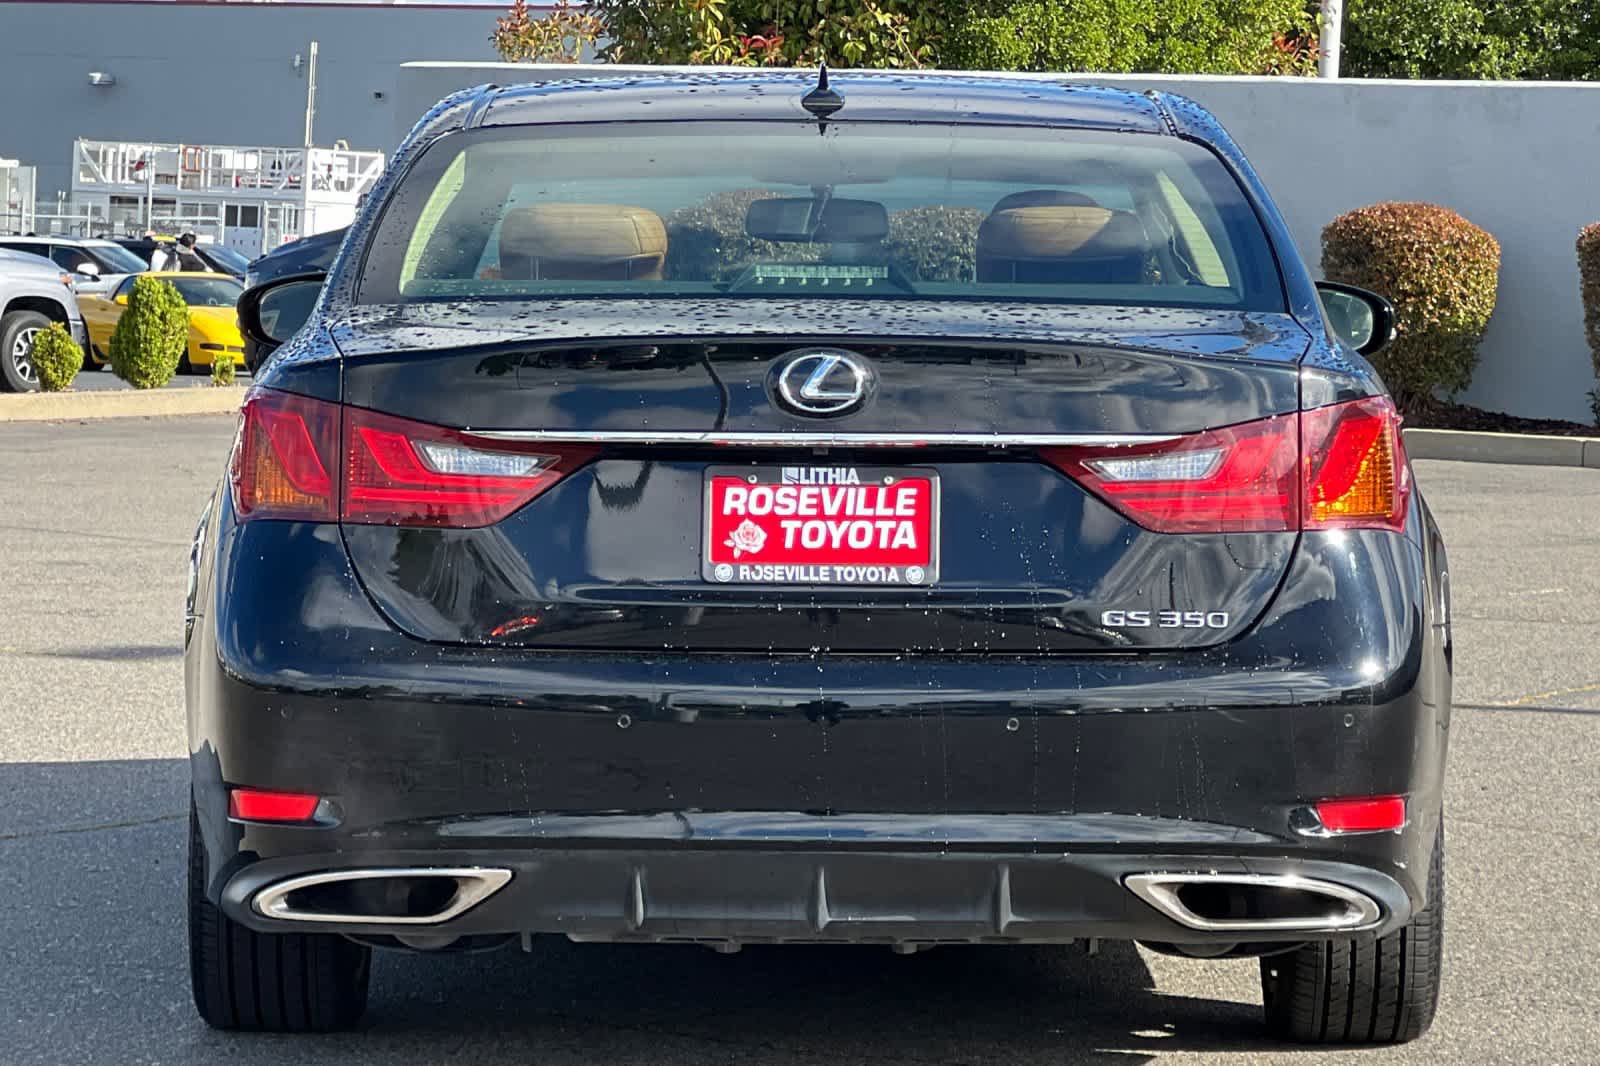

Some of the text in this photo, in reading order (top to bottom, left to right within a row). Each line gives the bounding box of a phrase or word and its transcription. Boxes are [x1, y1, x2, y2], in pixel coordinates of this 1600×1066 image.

[799, 467, 860, 485] LITHIA
[722, 486, 918, 517] ROSEVILLE
[780, 520, 917, 550] TOYOTA
[739, 565, 899, 582] ROSEVILLE TOYOTA
[1101, 610, 1229, 628] GS 350
